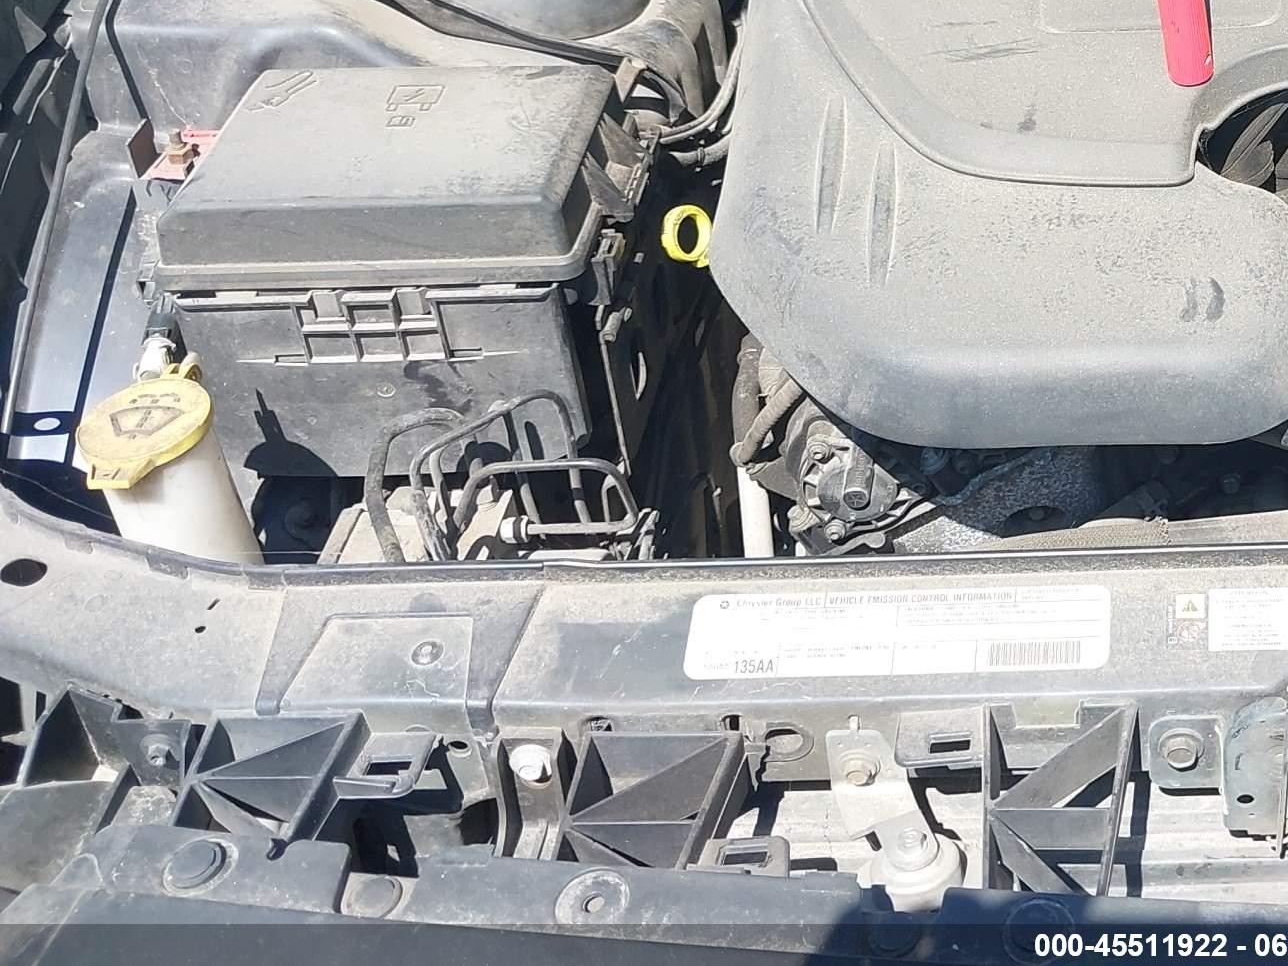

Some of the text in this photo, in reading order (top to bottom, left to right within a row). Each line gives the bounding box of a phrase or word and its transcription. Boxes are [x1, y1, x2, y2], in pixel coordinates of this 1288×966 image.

[776, 598, 802, 608] Group
[805, 596, 822, 606] LLC
[829, 595, 864, 605] VEHICLE
[867, 594, 908, 604] EMISSION
[911, 593, 949, 603] CONTROL
[953, 592, 1013, 602] INFORMATION
[734, 659, 774, 674] 135AA
